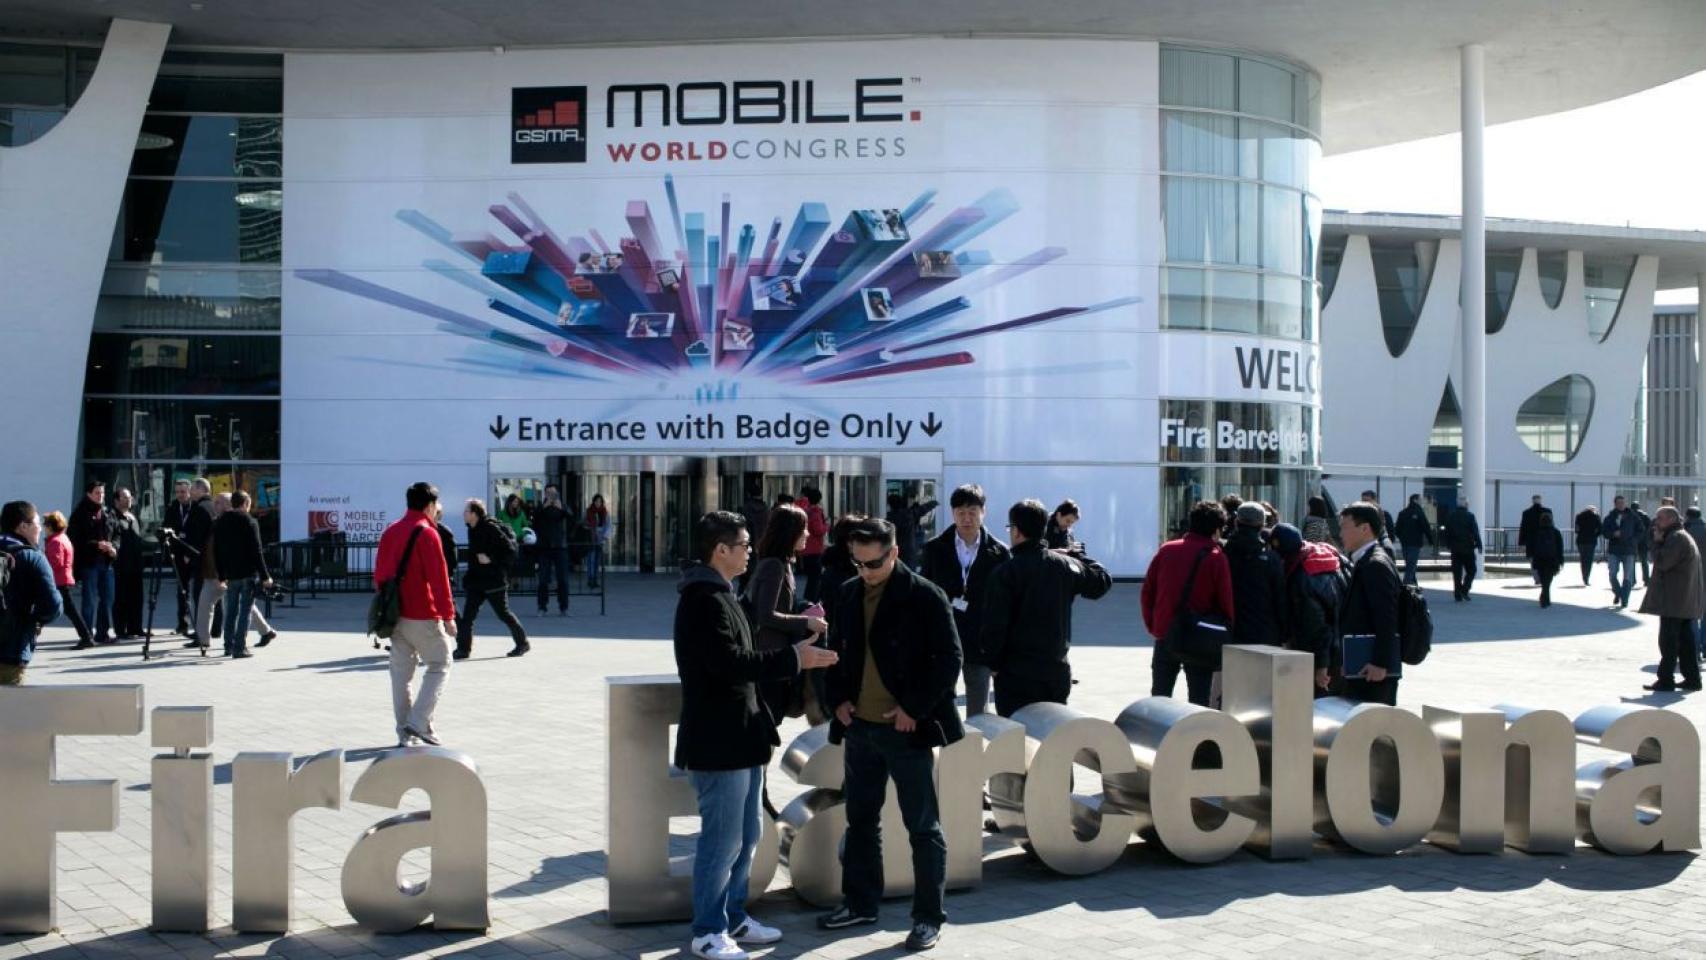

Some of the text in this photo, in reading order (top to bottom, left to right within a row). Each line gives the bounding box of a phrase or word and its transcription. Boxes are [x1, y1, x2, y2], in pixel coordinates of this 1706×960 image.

[515, 128, 579, 143] GSMA
[1235, 346, 1316, 394] WELC
[518, 411, 913, 445] Entrance with Badge Only
[1161, 418, 1308, 452] Fira Barcelona
[344, 511, 386, 521] MOBILE
[344, 522, 383, 532] WORLD
[344, 532, 380, 542] BARCE
[0, 684, 490, 934] Fira
